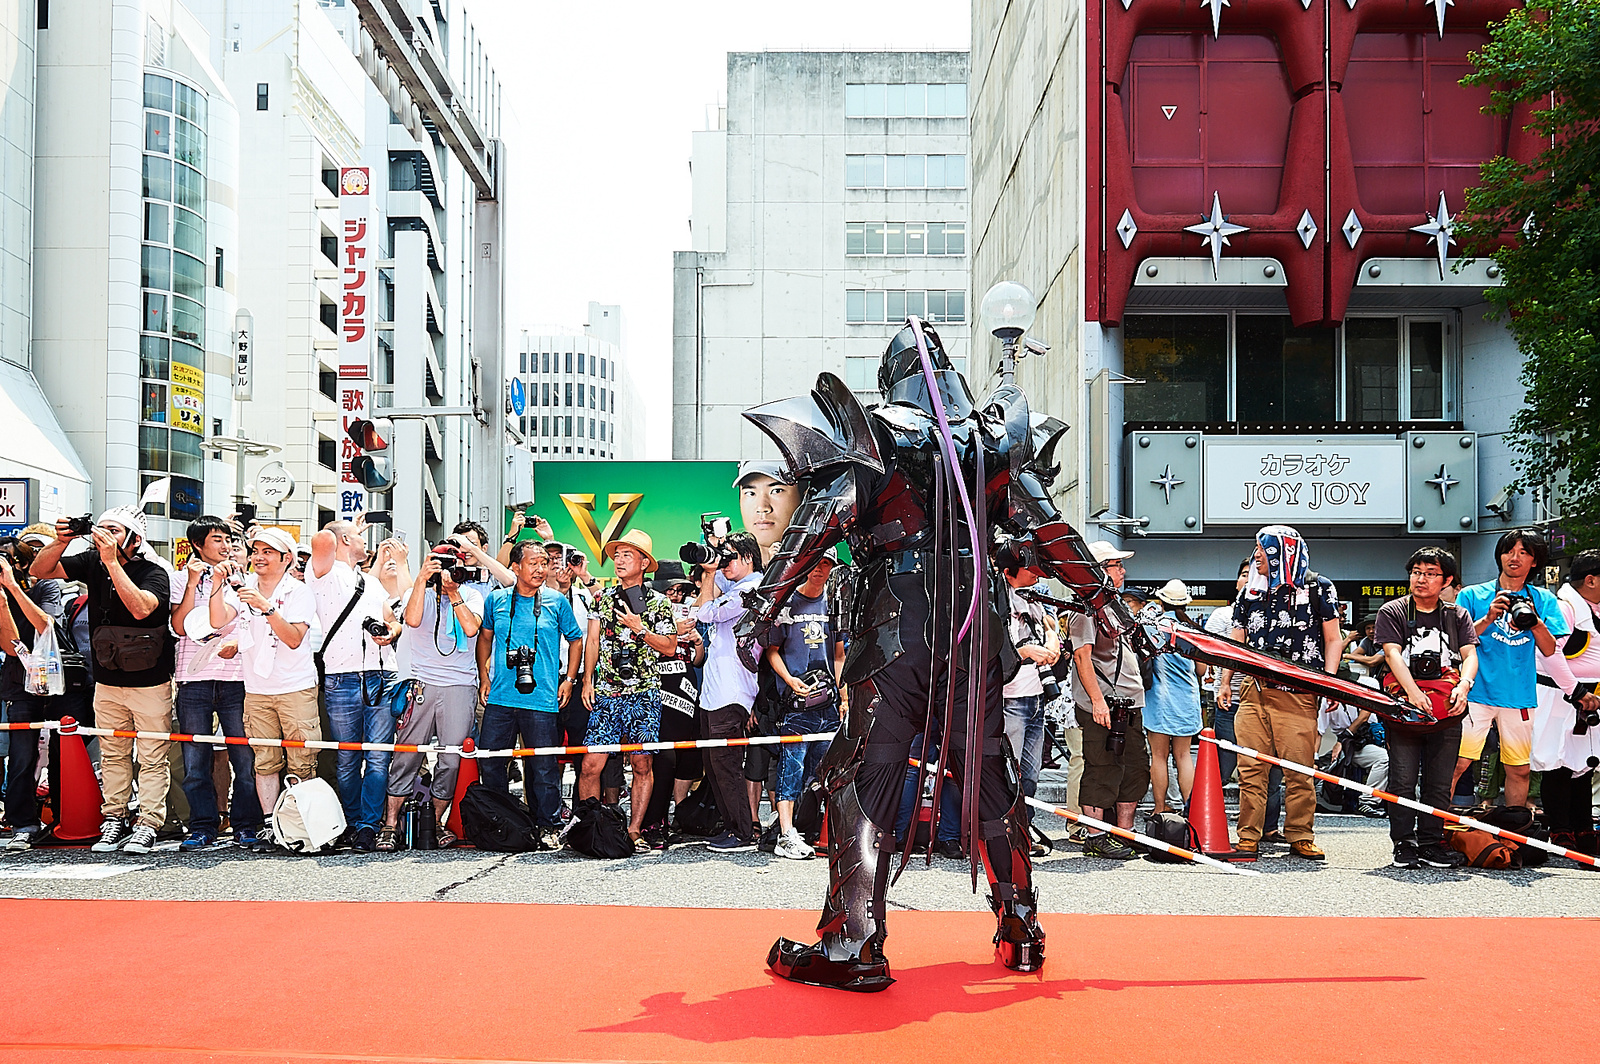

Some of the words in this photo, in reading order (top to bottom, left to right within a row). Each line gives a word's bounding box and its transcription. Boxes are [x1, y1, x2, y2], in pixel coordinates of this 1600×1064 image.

[343, 218, 366, 342] ジャンカラ
[238, 330, 248, 386] 大野屋ビル
[1260, 453, 1350, 476] カラオケ
[265, 488, 282, 496] タワー
[1241, 482, 1303, 510] JOY
[1308, 482, 1370, 510] JOY
[1491, 631, 1531, 647] OKINAWA
[674, 662, 684, 672] TO
